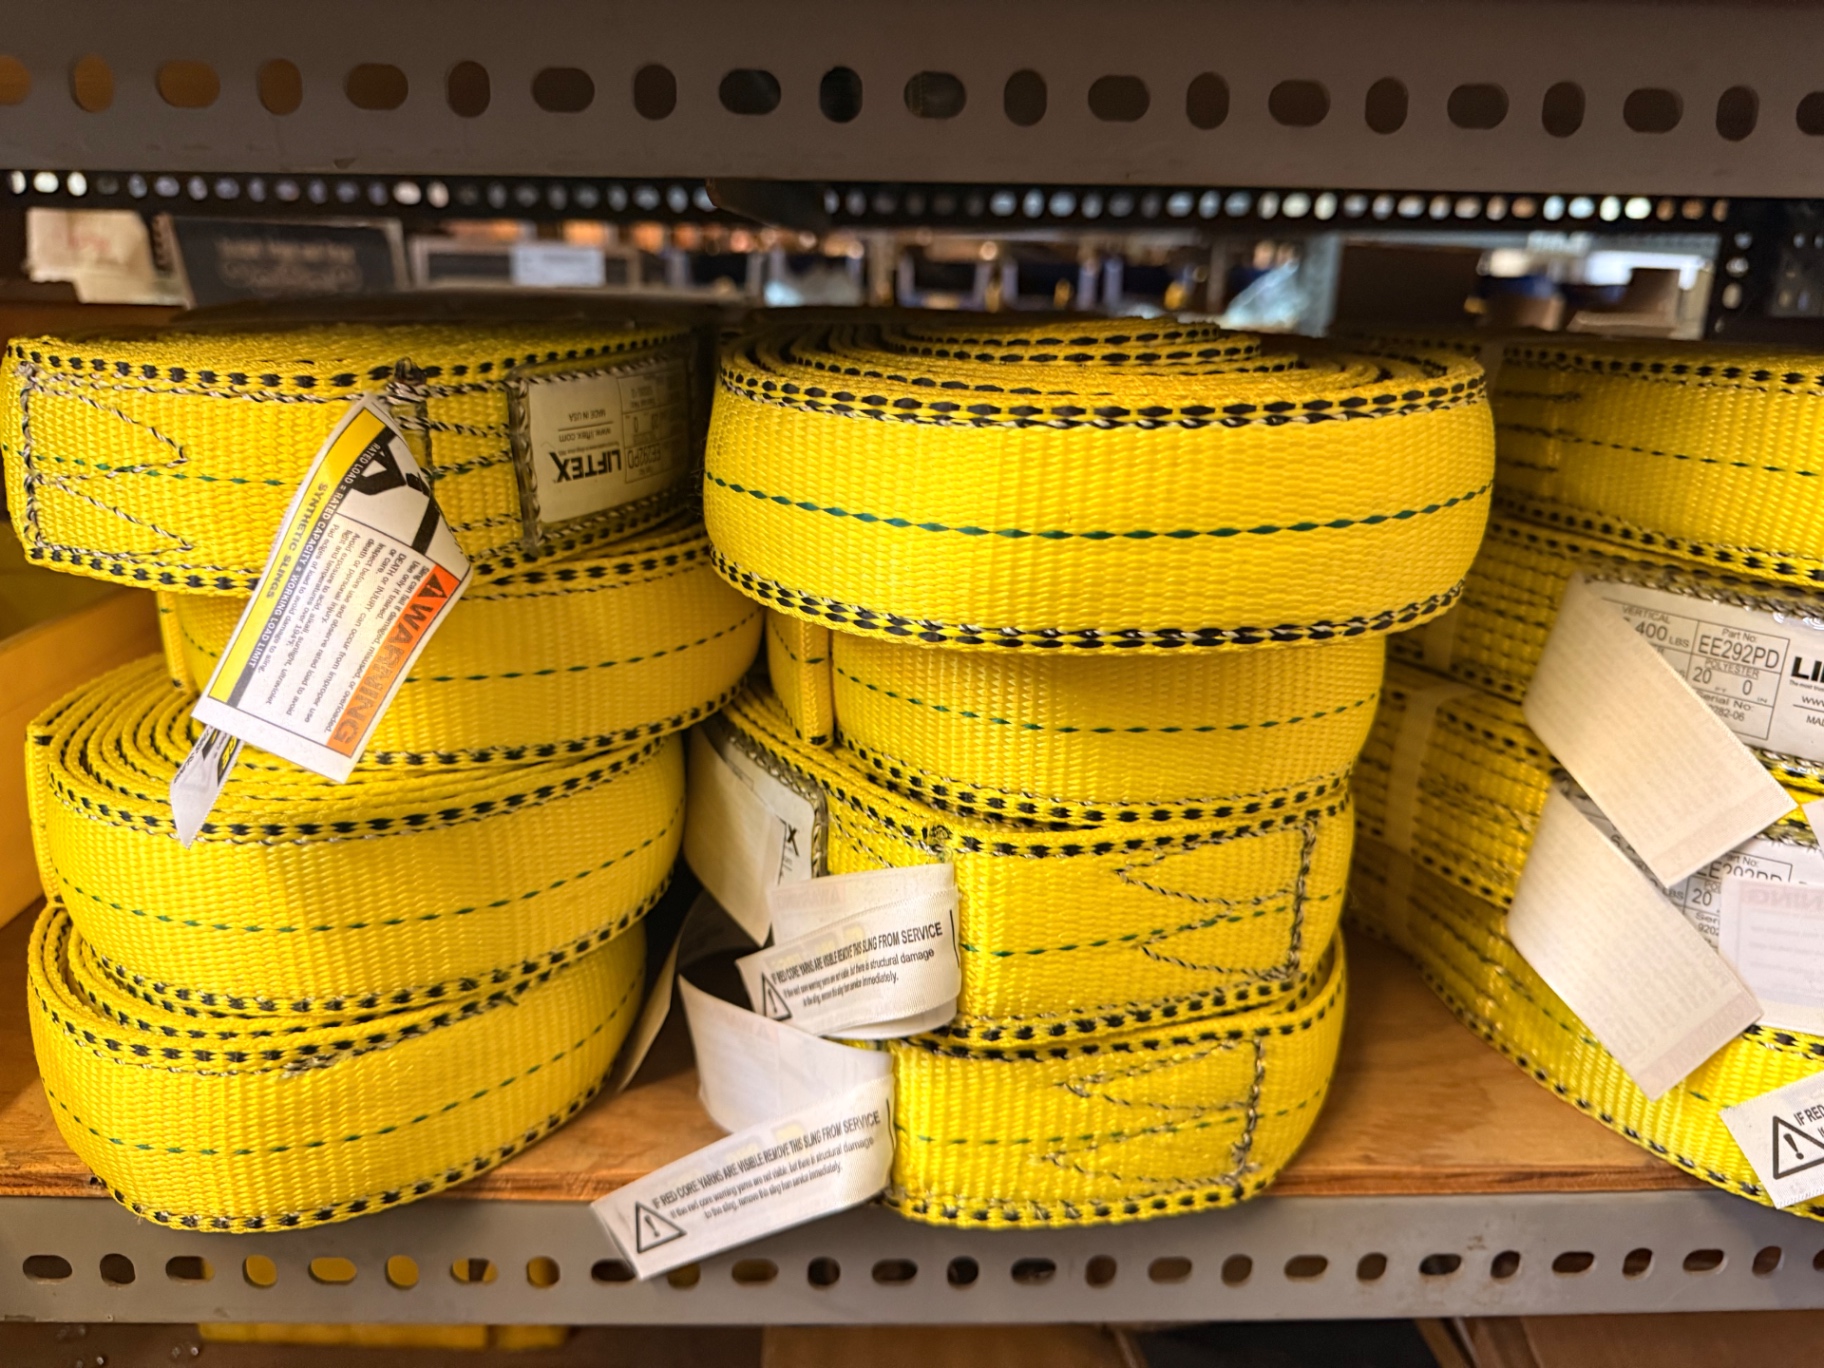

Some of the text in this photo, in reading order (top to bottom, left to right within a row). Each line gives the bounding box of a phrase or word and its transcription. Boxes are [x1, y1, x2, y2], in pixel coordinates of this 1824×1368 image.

[358, 442, 380, 464] RATED
[549, 449, 622, 482] LIFTEX
[343, 463, 363, 484] LOAD
[321, 491, 342, 520] RATED
[265, 482, 327, 600] SYNTHETIC SLINGS
[298, 520, 326, 564] CAPACITY
[330, 545, 342, 559] and
[344, 532, 360, 552] Avoid
[326, 552, 348, 584] exposure
[375, 548, 396, 575] or care.
[407, 560, 420, 574] Use
[412, 565, 430, 582] Sling
[306, 559, 334, 606] temperatures
[320, 538, 375, 624] death or personal injury.
[321, 585, 330, 594] to
[395, 573, 410, 588] only
[405, 581, 417, 594] can
[256, 523, 339, 674] Pad edges of load to avoid damage to sling.
[273, 573, 299, 616] WORKING
[375, 594, 396, 621] trained.
[398, 594, 409, 605] fail
[298, 607, 310, 623] over
[261, 617, 278, 641] LOAD
[285, 542, 385, 716] Inspect before use and observe rated load to avoid
[303, 552, 406, 723] DEATH or INJURY can occur from improper use
[371, 611, 397, 647] damaged,
[1669, 636, 1690, 648] LBS
[1722, 628, 1741, 641] Part
[247, 642, 265, 668] LIMIT
[352, 646, 375, 680] misused,
[1698, 634, 1779, 669] EE292PD
[333, 599, 433, 746] WARNING
[1693, 667, 1712, 684] 20
[1742, 679, 1753, 696] 0
[1705, 659, 1759, 680] POLYESTER
[347, 680, 355, 690] or
[323, 690, 351, 734] overloaded.
[1692, 888, 1712, 906] 20
[861, 936, 879, 952] SLING
[876, 931, 901, 949] FROM
[899, 921, 943, 944] SERVICE
[1794, 1111, 1805, 1126] IF
[659, 1189, 678, 1206] RED
[676, 1179, 700, 1198] CORE
[696, 1168, 724, 1189] YARNS
[722, 1163, 738, 1179] ARE
[736, 1152, 764, 1173] VISIBLE
[762, 1142, 790, 1163] REMOVE
[788, 1136, 804, 1153] THIS
[801, 1129, 823, 1148] SLING
[820, 1122, 843, 1141] FROM
[841, 1110, 881, 1133] SERVICE
